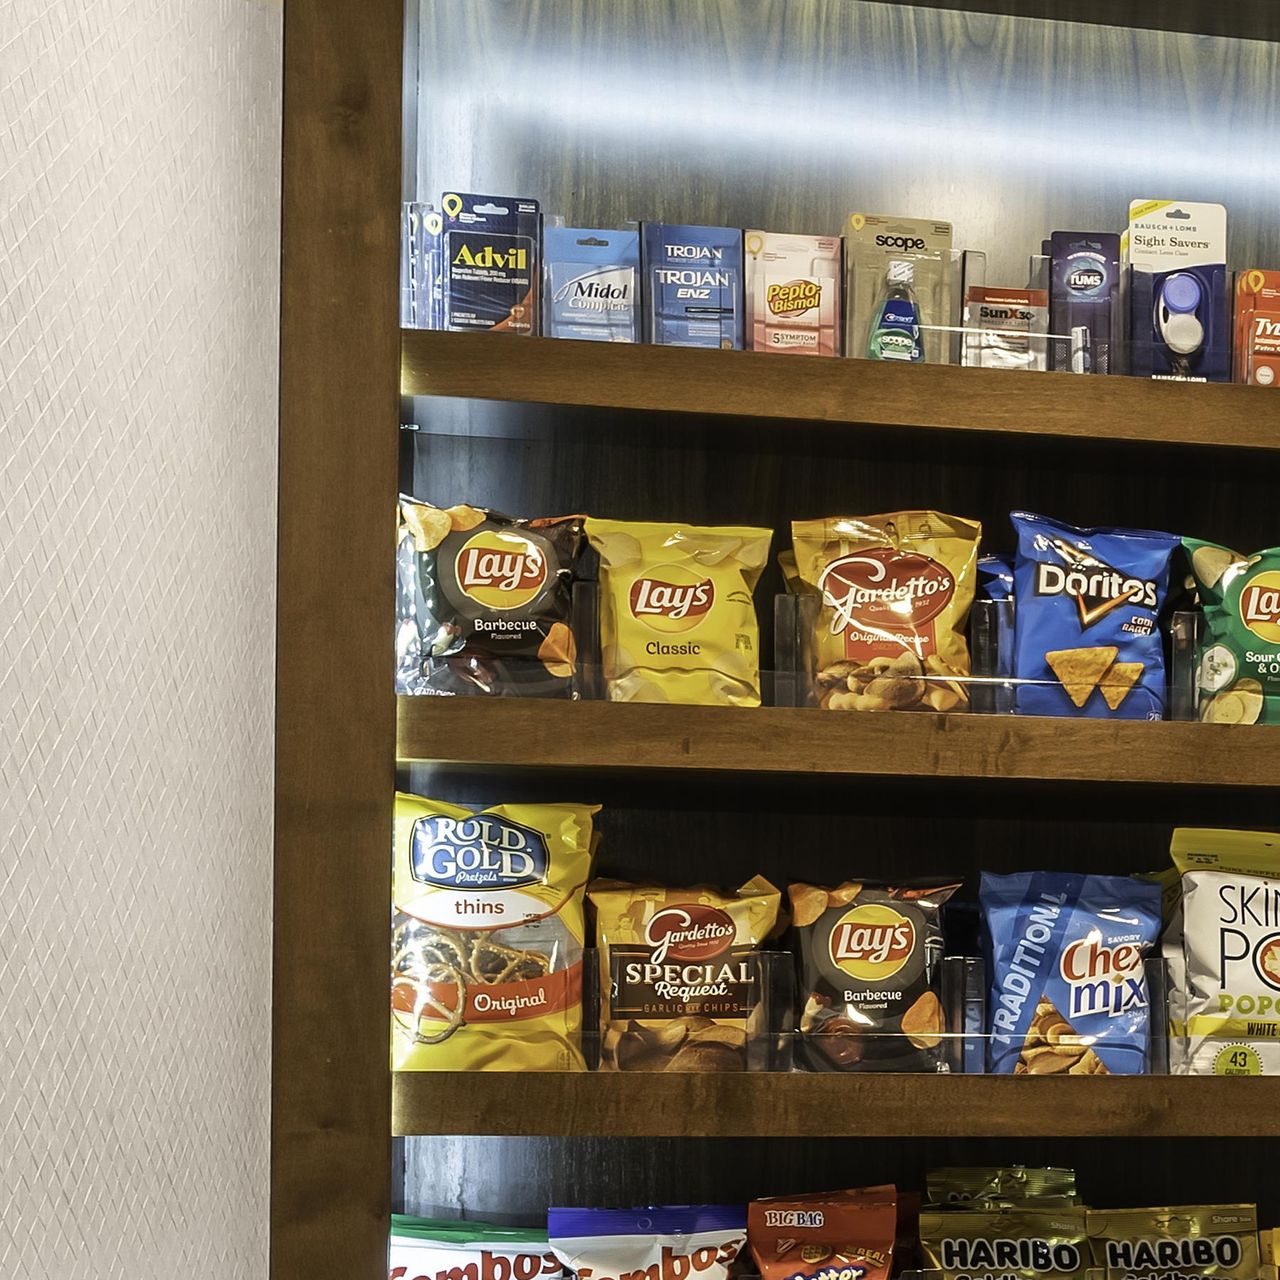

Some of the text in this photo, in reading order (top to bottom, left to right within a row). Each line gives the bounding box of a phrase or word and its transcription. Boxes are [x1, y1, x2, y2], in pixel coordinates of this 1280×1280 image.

[1134, 234, 1208, 249] Sight Savers
[452, 243, 527, 270] Advil
[664, 244, 722, 260] TROJAN
[656, 269, 729, 286] TROJAN
[574, 281, 628, 300] Midol
[676, 287, 711, 299] ENZ
[773, 295, 820, 313] Bismol
[880, 333, 912, 348] scope
[1038, 563, 1158, 607] Doritos
[634, 579, 711, 619] Lay's
[474, 618, 538, 633] Barbecue
[646, 641, 701, 655] Classic
[1246, 652, 1276, 664] Sour
[1258, 664, 1268, 674] &
[436, 816, 529, 850] ROLD
[424, 844, 536, 879] GOLD
[456, 871, 497, 883] Pretzels
[455, 897, 505, 915] thins
[645, 909, 736, 966] Gardetto's
[1107, 934, 1141, 945] SAVORY
[1061, 938, 1145, 980] Chex
[626, 962, 755, 985] SPECIAL
[654, 981, 729, 1001] Request
[844, 990, 902, 1002] Barbecue
[1073, 974, 1147, 1018] mix
[474, 990, 547, 1015] Original
[1247, 1022, 1278, 1037] WHITE
[1230, 1050, 1248, 1067] 43
[766, 1210, 824, 1227] BIG BAG
[1212, 1215, 1238, 1224] Share
[857, 1247, 885, 1263] REAL
[941, 1238, 1080, 1272] HARIBO
[1106, 1234, 1242, 1270] HARIBO
